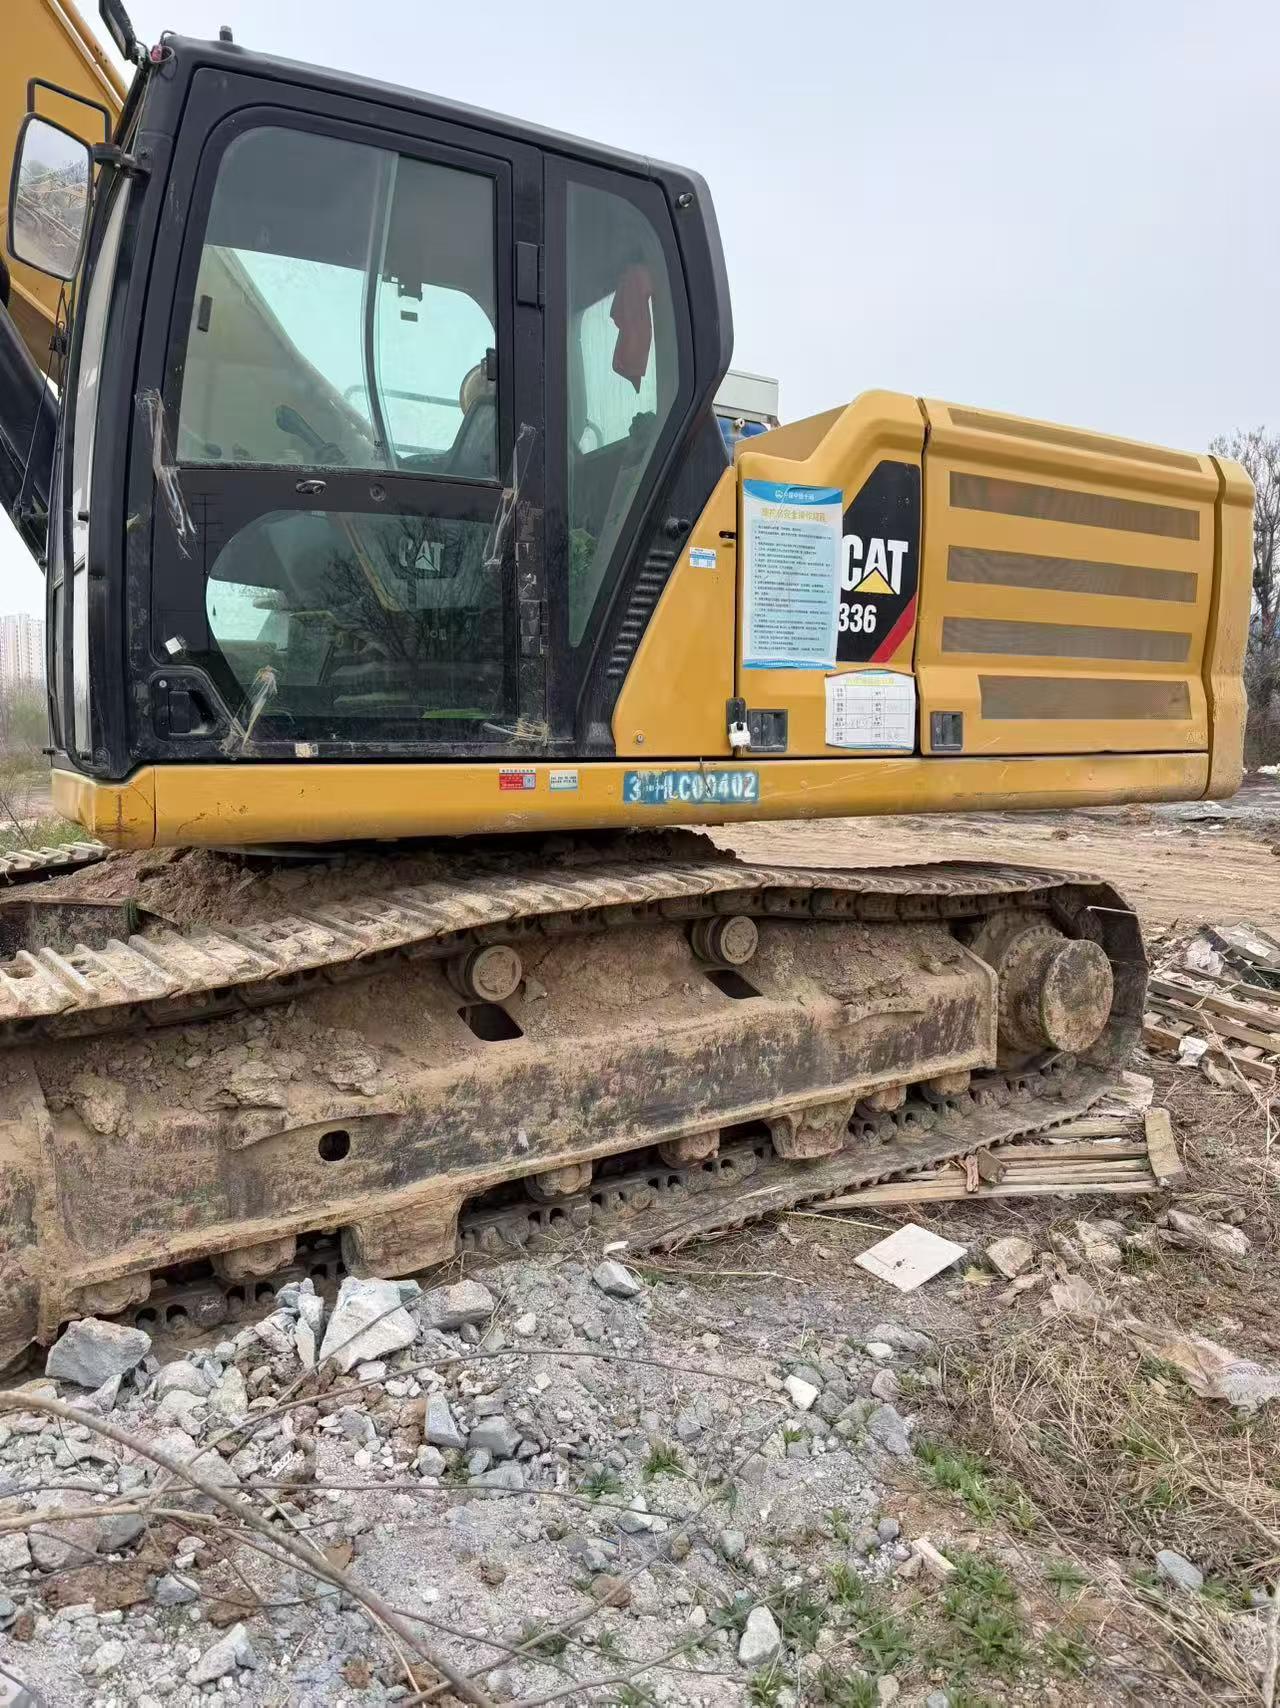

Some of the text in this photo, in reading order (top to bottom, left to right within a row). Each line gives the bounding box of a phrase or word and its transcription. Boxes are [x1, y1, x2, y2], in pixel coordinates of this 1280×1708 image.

[399, 537, 445, 571] CAT
[842, 534, 909, 595] CAT
[839, 603, 878, 633] 336
